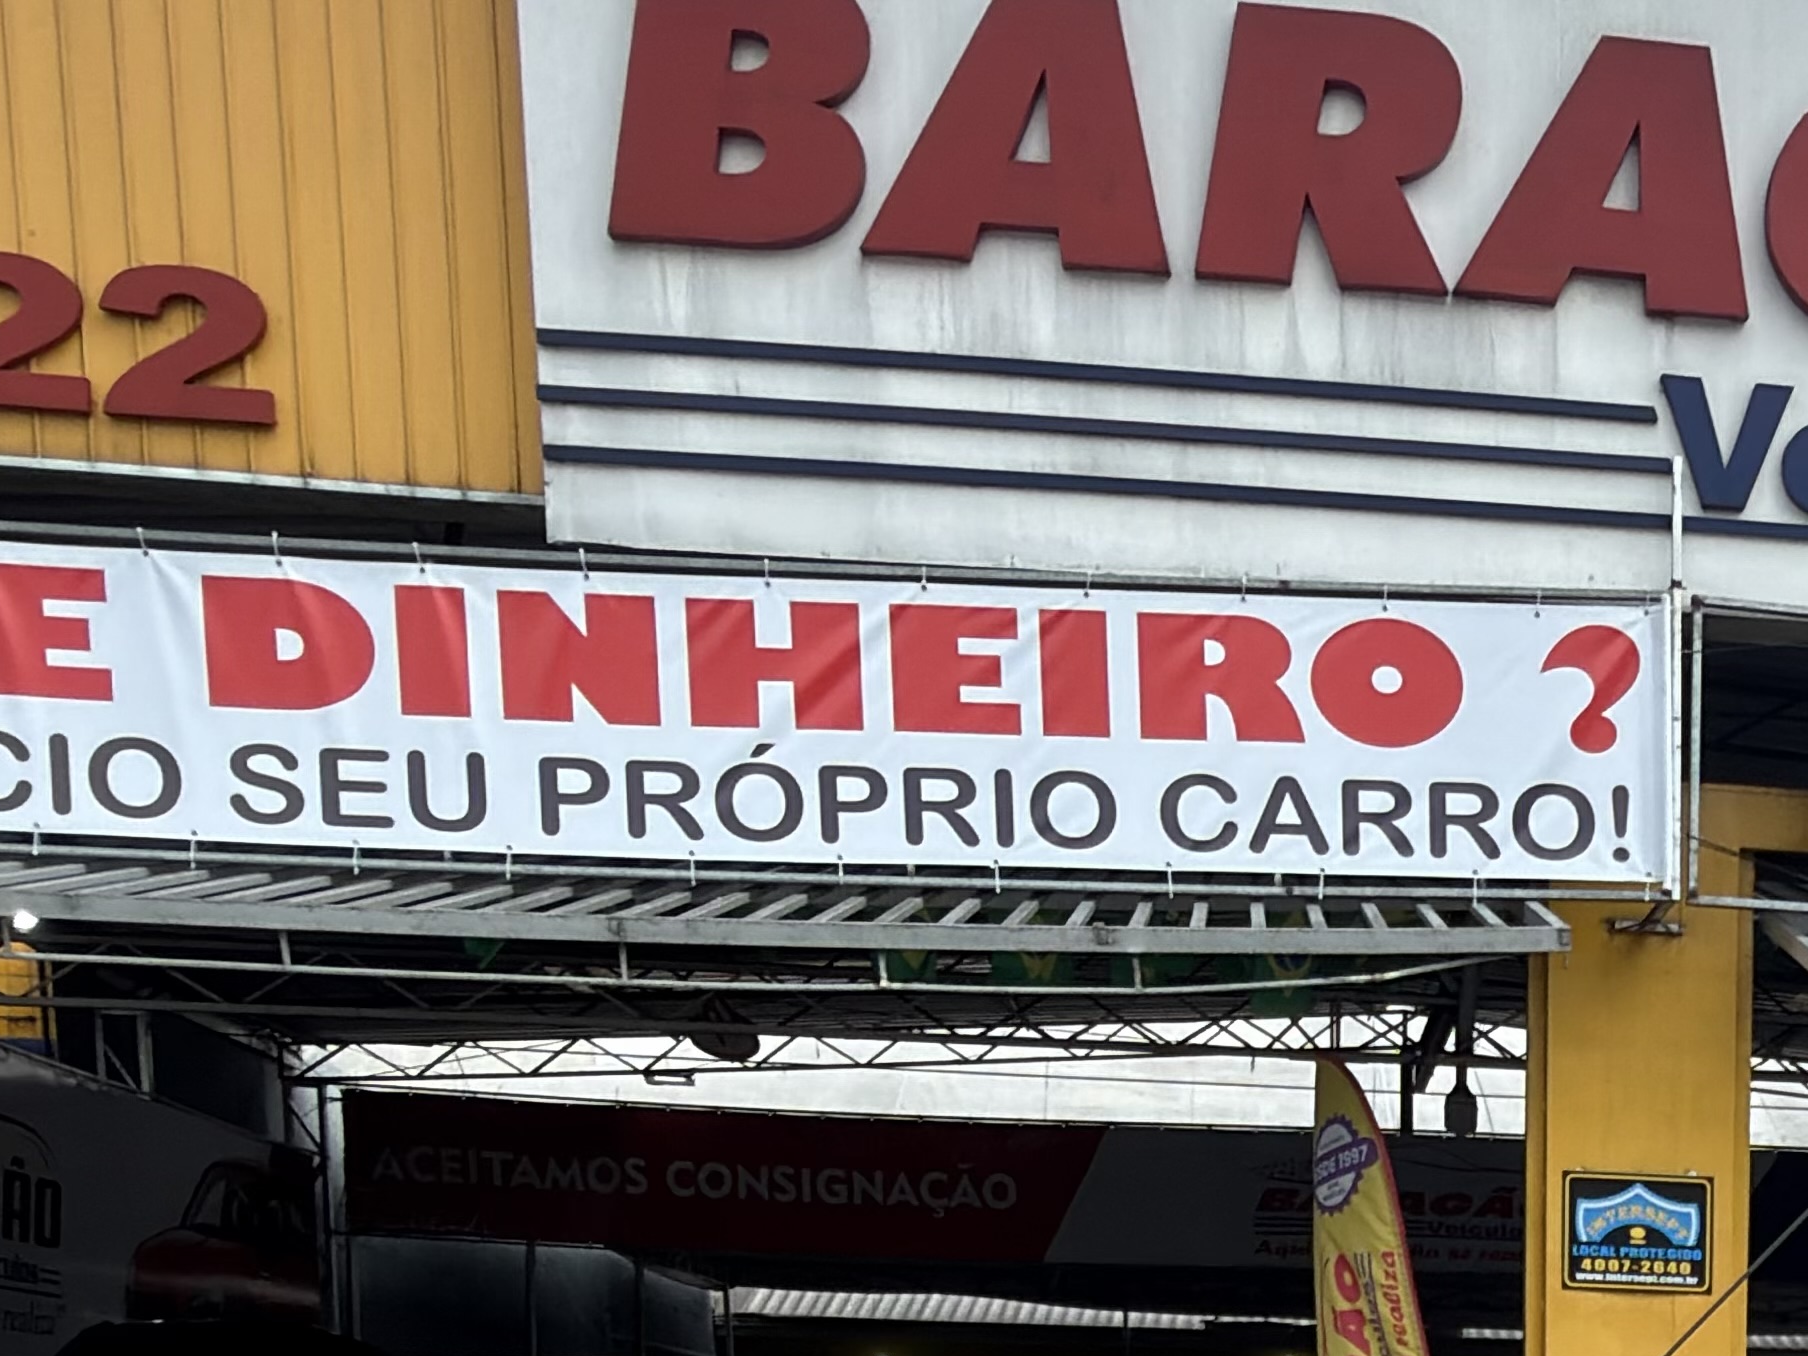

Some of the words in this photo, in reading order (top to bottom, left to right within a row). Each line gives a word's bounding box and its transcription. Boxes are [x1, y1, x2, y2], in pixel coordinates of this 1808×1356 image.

[204, 574, 1464, 748] DINHEIRO
[1540, 624, 1641, 755] ?
[229, 745, 488, 833] SEU
[539, 744, 1118, 851] PRÓPRIO
[1159, 772, 1632, 862] CARRO!
[372, 1145, 649, 1197] ACEITAMOS
[666, 1160, 1019, 1218] CONSIGNAÇÃO
[1337, 1144, 1368, 1169] 1997
[1572, 1244, 1616, 1257] LOCAL
[1620, 1246, 1703, 1261] PROTEGIDO
